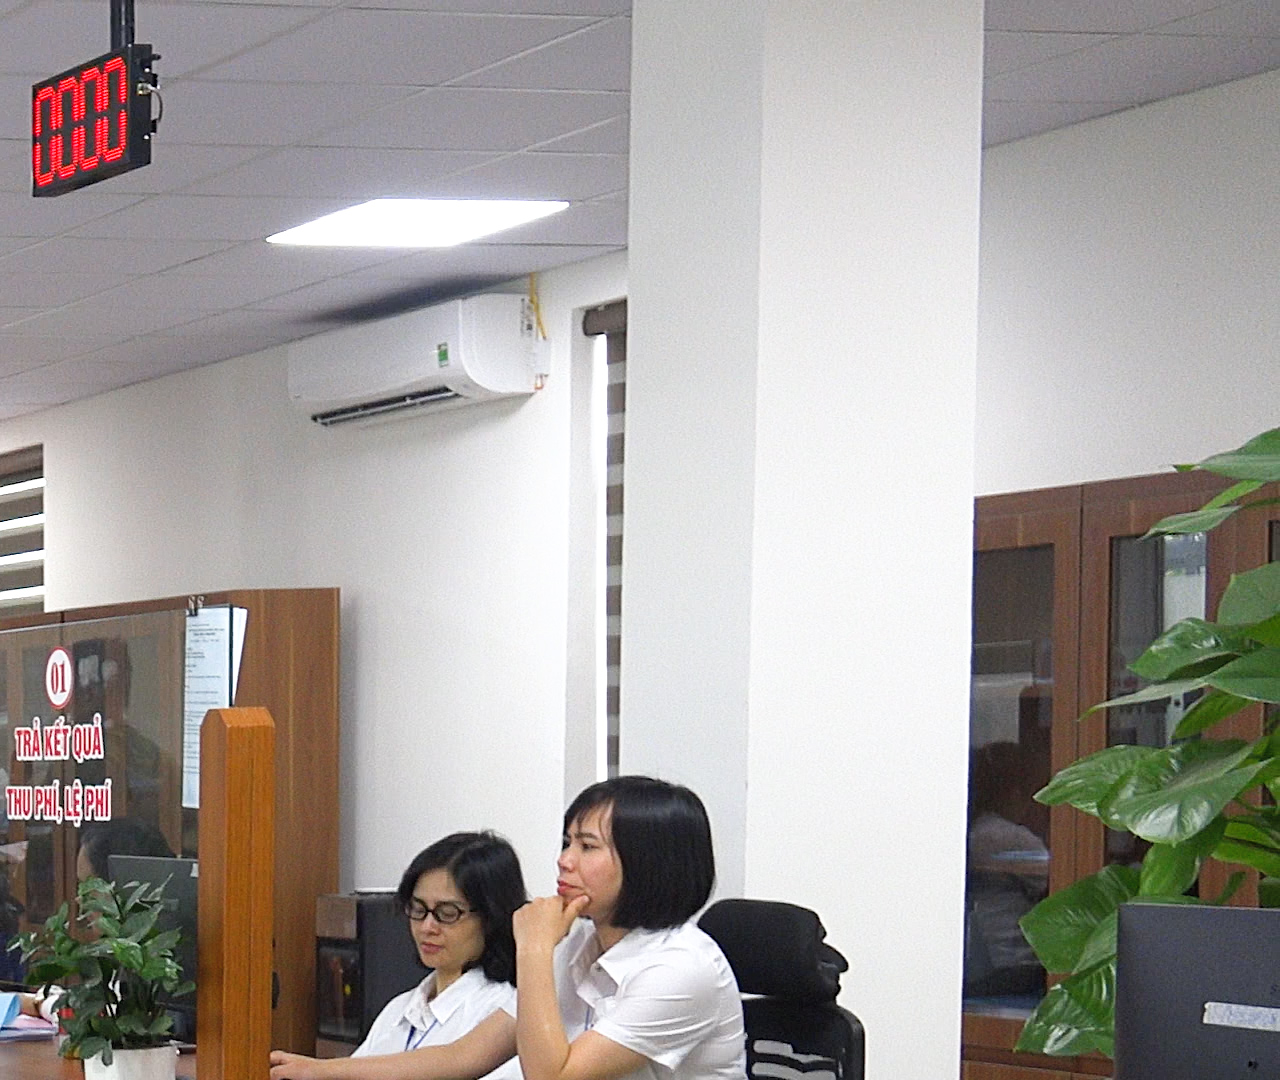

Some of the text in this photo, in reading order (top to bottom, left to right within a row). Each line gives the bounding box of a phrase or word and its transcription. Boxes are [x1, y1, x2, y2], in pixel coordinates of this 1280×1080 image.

[33, 56, 128, 188] 0000
[51, 661, 67, 695] 01
[15, 715, 103, 760] TRẢ KẾT QUẢ
[6, 781, 110, 824] THU PHÍ, LỆ PHÍ
